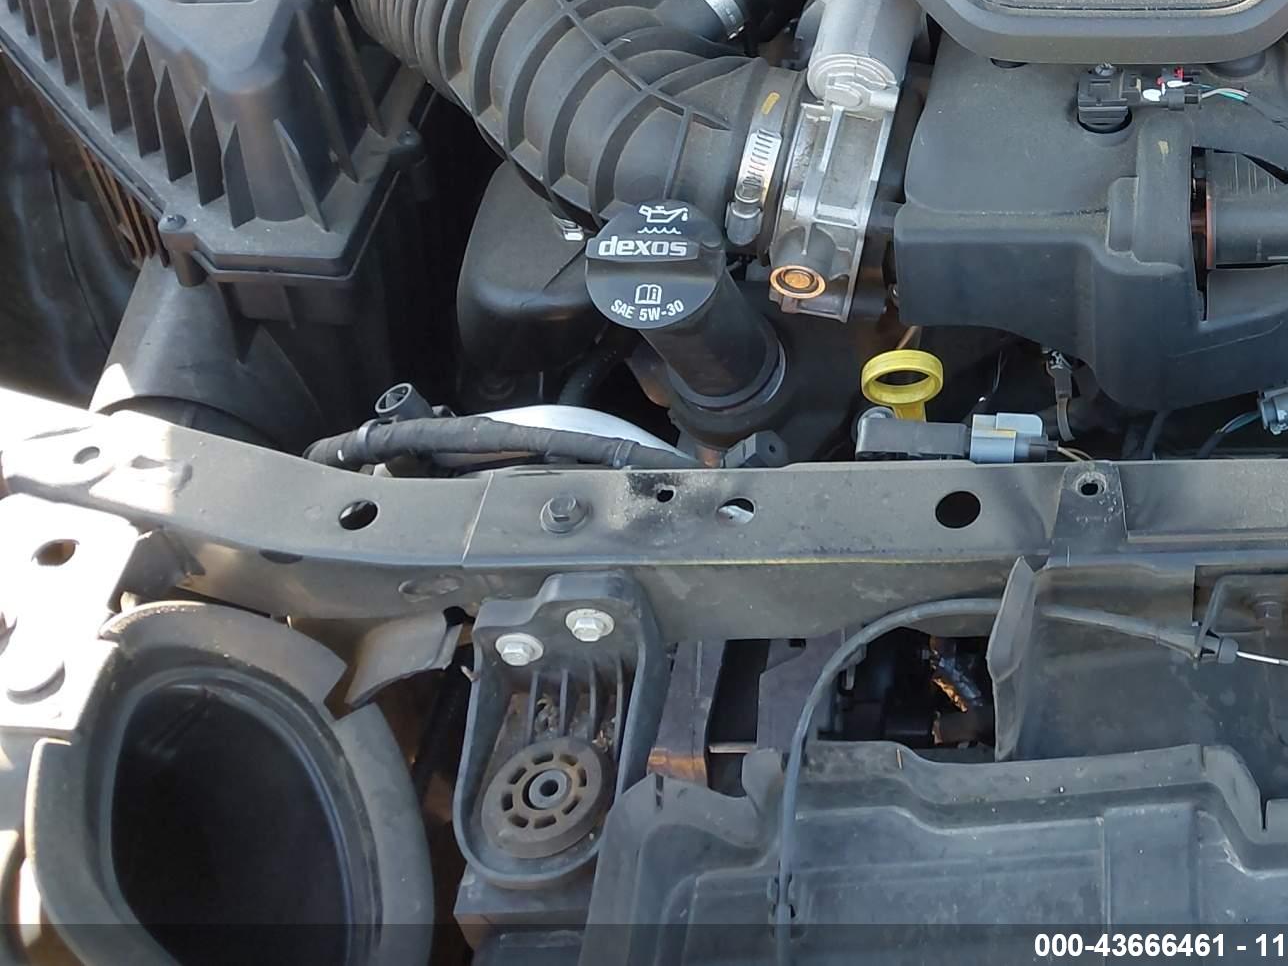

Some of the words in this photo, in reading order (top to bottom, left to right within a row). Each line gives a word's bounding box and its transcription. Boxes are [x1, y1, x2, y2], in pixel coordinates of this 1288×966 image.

[598, 236, 688, 256] dexos
[610, 299, 636, 319] SAE
[639, 299, 685, 322] 5W-30
